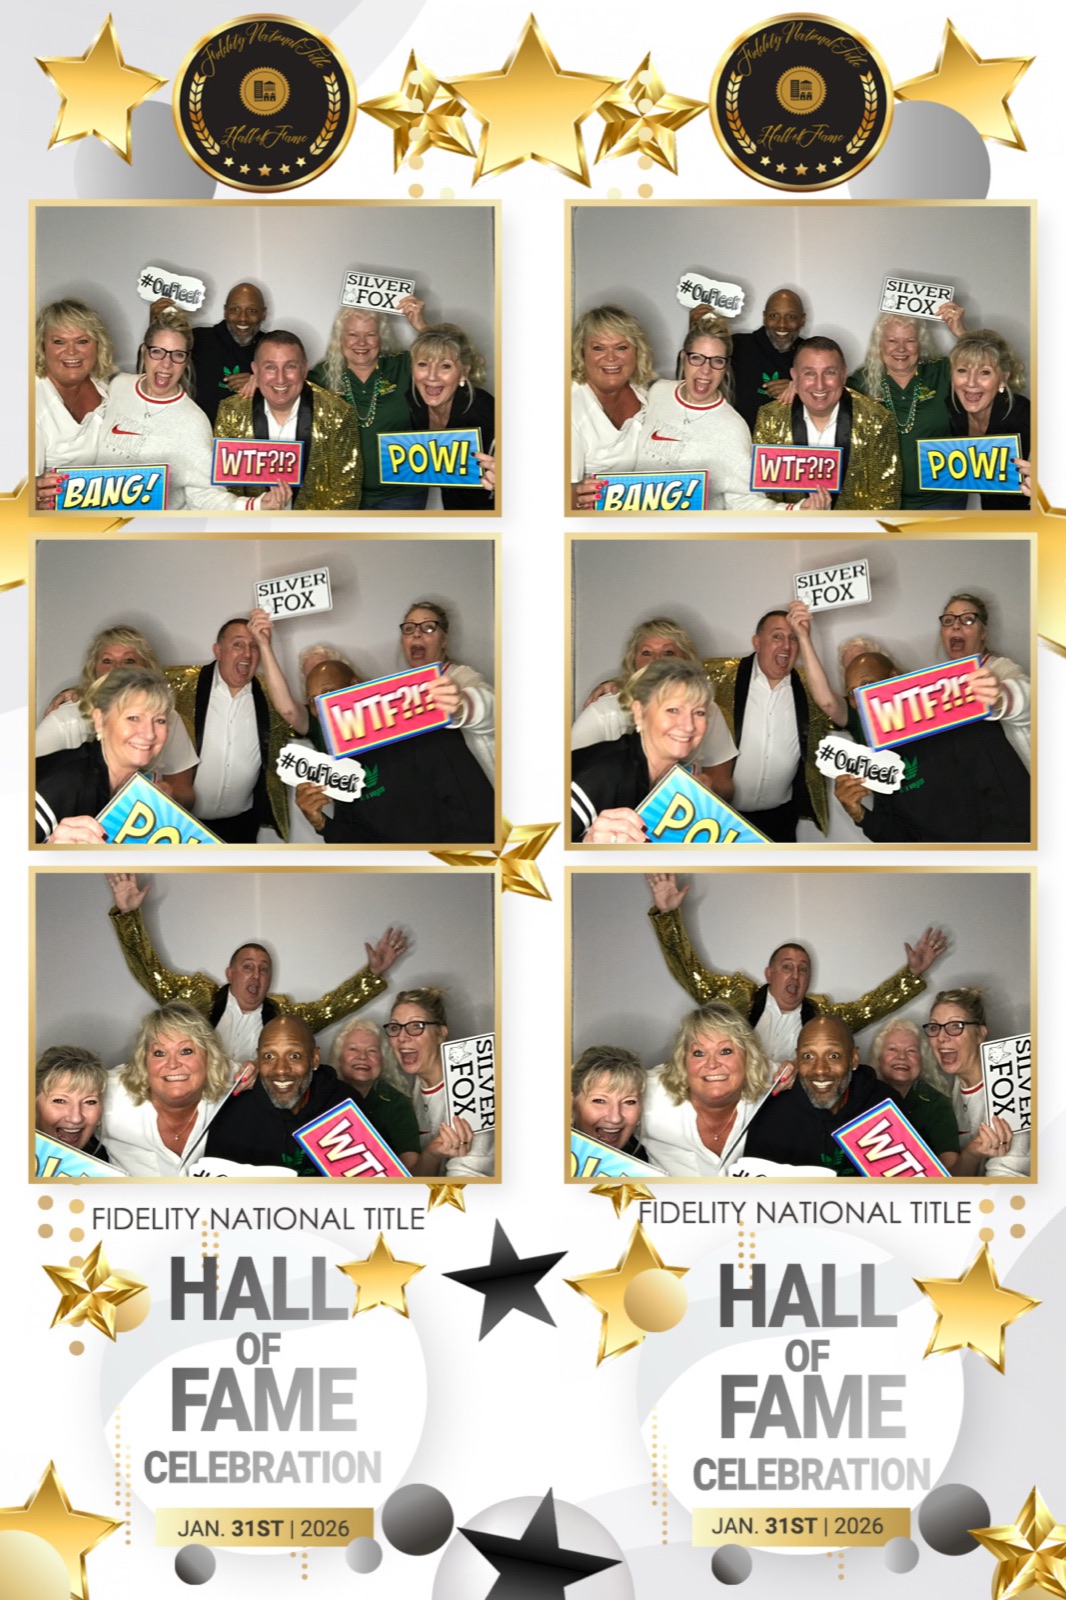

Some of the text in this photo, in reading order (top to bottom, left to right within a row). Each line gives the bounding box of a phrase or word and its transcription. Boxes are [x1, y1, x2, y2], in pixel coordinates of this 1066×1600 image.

[347, 274, 411, 294] SILVER
[887, 281, 950, 300] SILVER
[356, 289, 397, 309] FOX
[896, 295, 936, 315] FOX
[221, 447, 297, 476] WTF?!?
[388, 439, 470, 476] POW!
[760, 454, 836, 482] WTF?!?
[926, 445, 1010, 483] POW!
[62, 473, 161, 509] BANG!
[603, 479, 701, 510] BANG!
[259, 573, 326, 597] SILVER
[797, 565, 866, 589] SILVER
[272, 590, 316, 614] FOX
[811, 582, 855, 606] FOX
[450, 1060, 476, 1116] FOX
[476, 1039, 495, 1129] SILVER
[989, 1060, 1015, 1116] FOX
